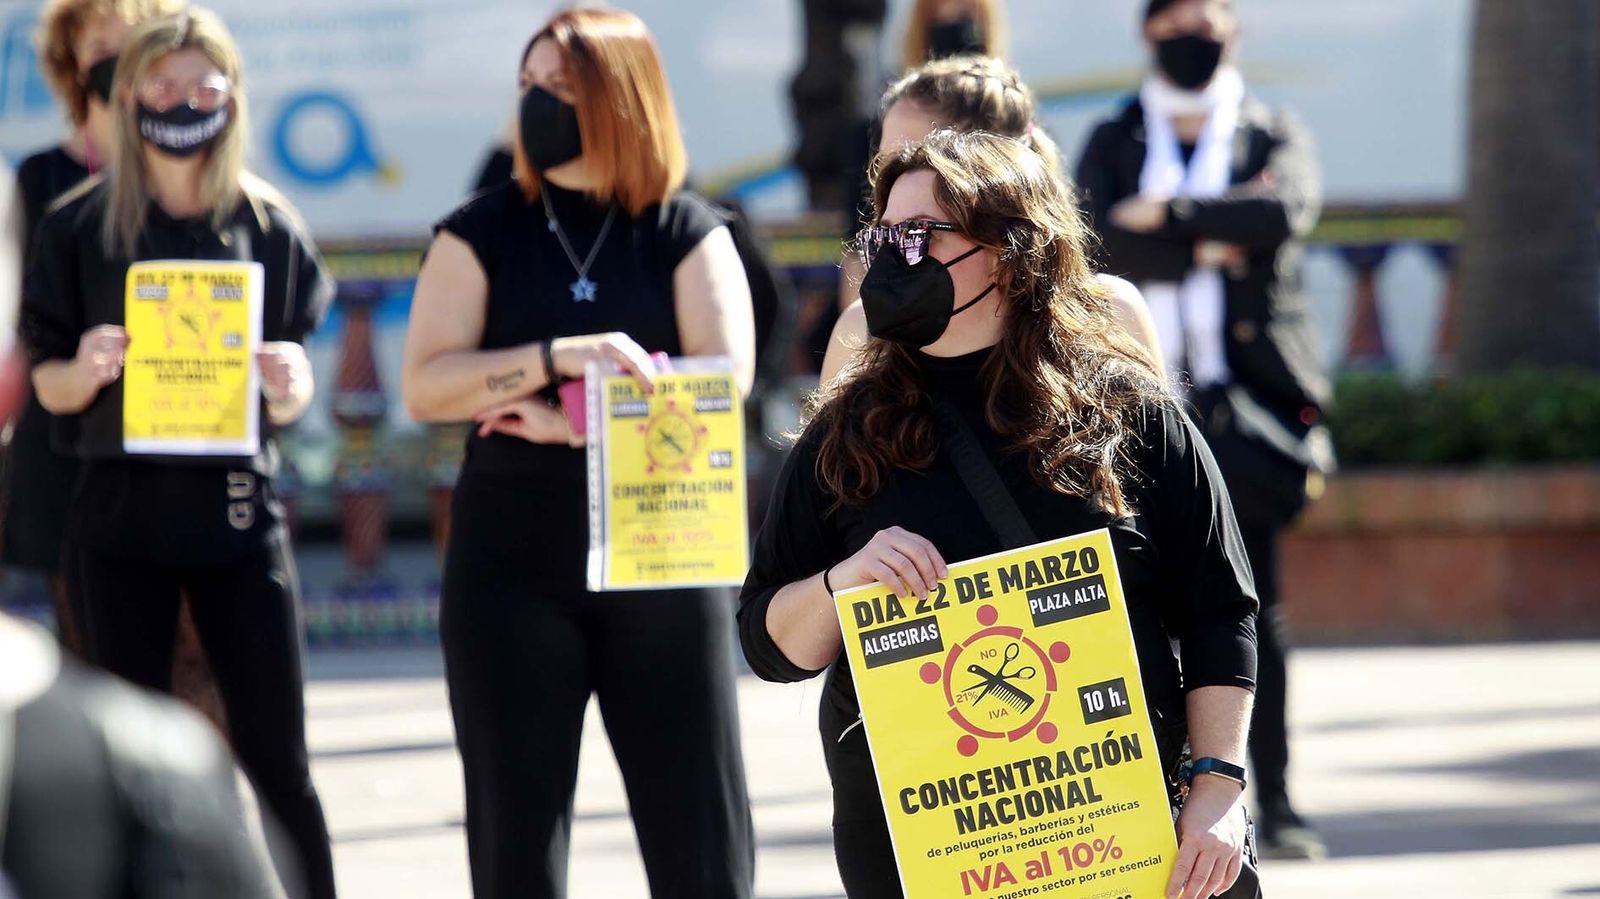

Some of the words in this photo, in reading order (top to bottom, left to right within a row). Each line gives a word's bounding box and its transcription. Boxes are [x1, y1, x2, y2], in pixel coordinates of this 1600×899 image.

[852, 592, 907, 629] DIA
[954, 571, 994, 605] DE
[997, 546, 1100, 594] MARZO
[1029, 590, 1072, 615] PLAZA
[1074, 583, 1107, 605] ALTA
[864, 622, 939, 657] ALGECIRAS
[980, 648, 998, 660] NO
[955, 690, 979, 704] 21%
[988, 707, 1009, 720] IVA
[1083, 691, 1105, 713] 10
[1108, 686, 1127, 708] h.
[899, 730, 1144, 815] CONCENTRACIÓN
[954, 777, 1103, 836] NACIONAL
[927, 848, 942, 859] de
[945, 831, 1018, 856] peluquerías,
[1019, 816, 1076, 837] barberías
[1077, 813, 1085, 824] y
[1088, 800, 1141, 820] estéticas
[979, 847, 1000, 862] por
[1002, 844, 1013, 855] la
[1016, 831, 1074, 851] reducción
[1076, 823, 1095, 837] del
[960, 861, 1018, 896] IVA
[1025, 850, 1053, 881] al
[1057, 835, 1124, 872] 10%
[1041, 875, 1076, 892] sector
[1079, 872, 1097, 885] por
[1099, 867, 1117, 878] ser
[1119, 854, 1163, 873] esencial
